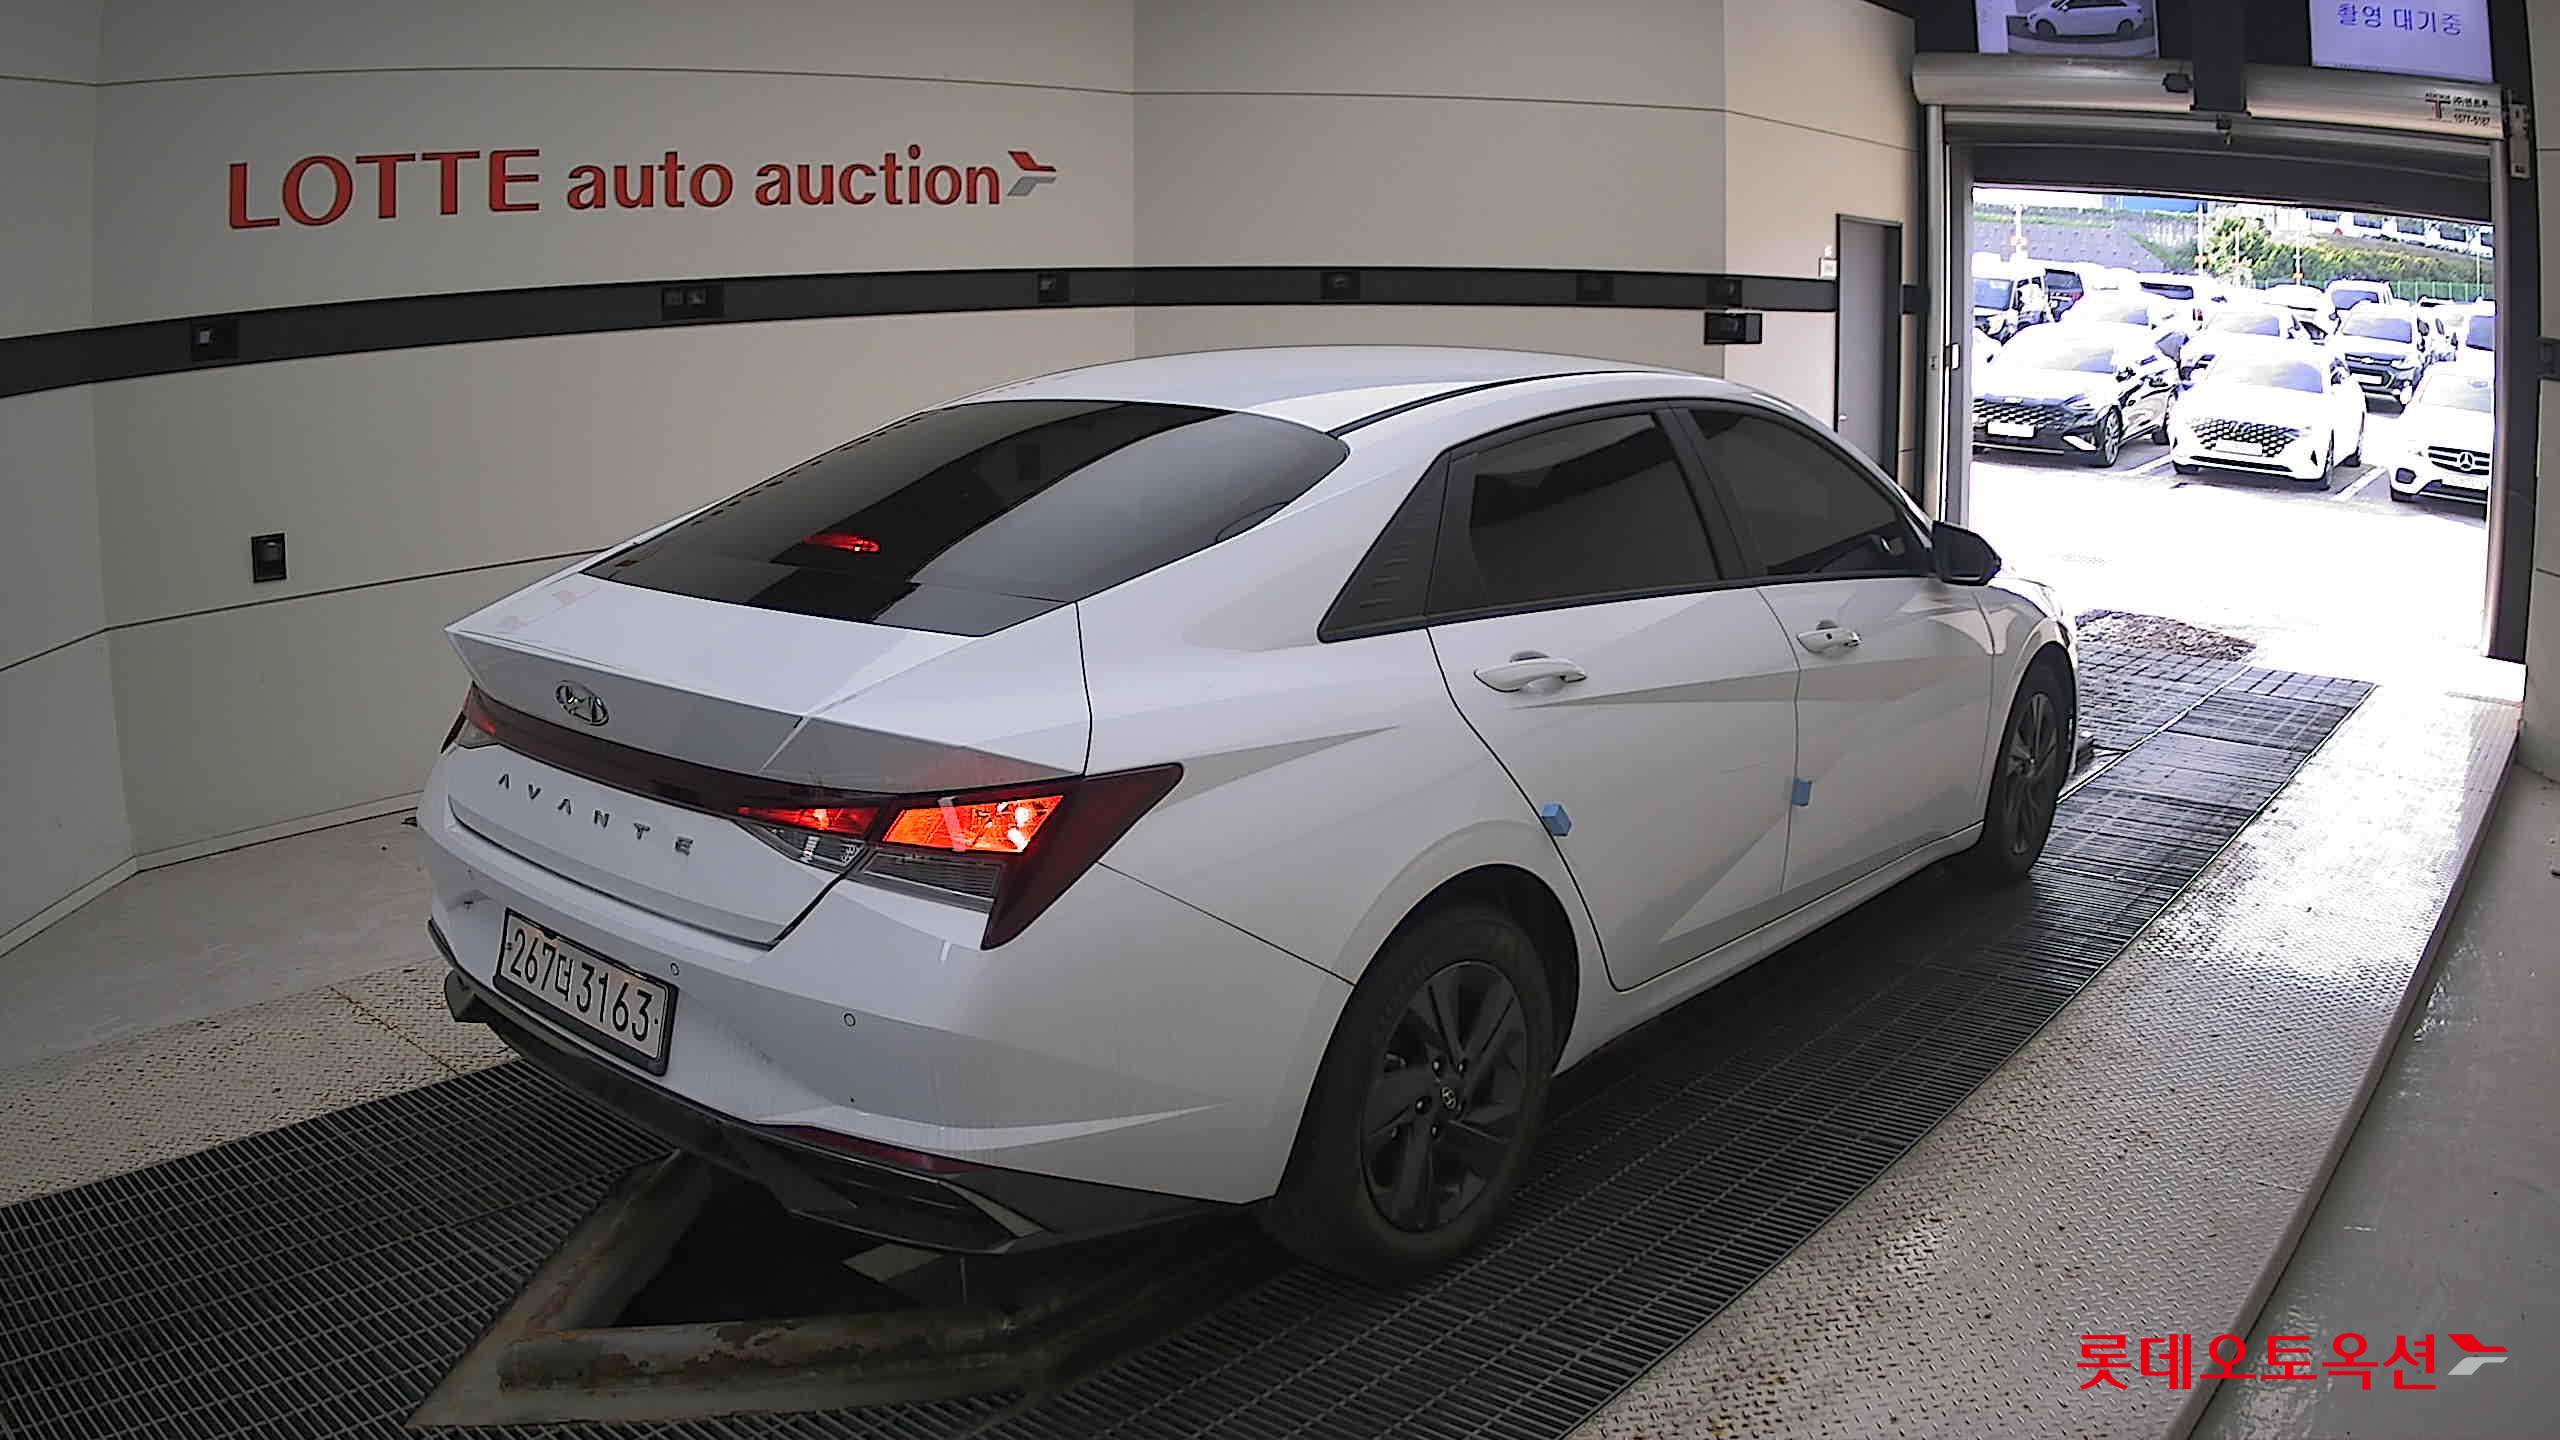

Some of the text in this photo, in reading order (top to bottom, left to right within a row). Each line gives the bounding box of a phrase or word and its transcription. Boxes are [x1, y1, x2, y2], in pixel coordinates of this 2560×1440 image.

[2392, 8, 2462, 36] 대기중
[229, 145, 1001, 229] LOTTE auto auction
[498, 772, 694, 856] AVANTE
[510, 927, 655, 1043] 267더3163
